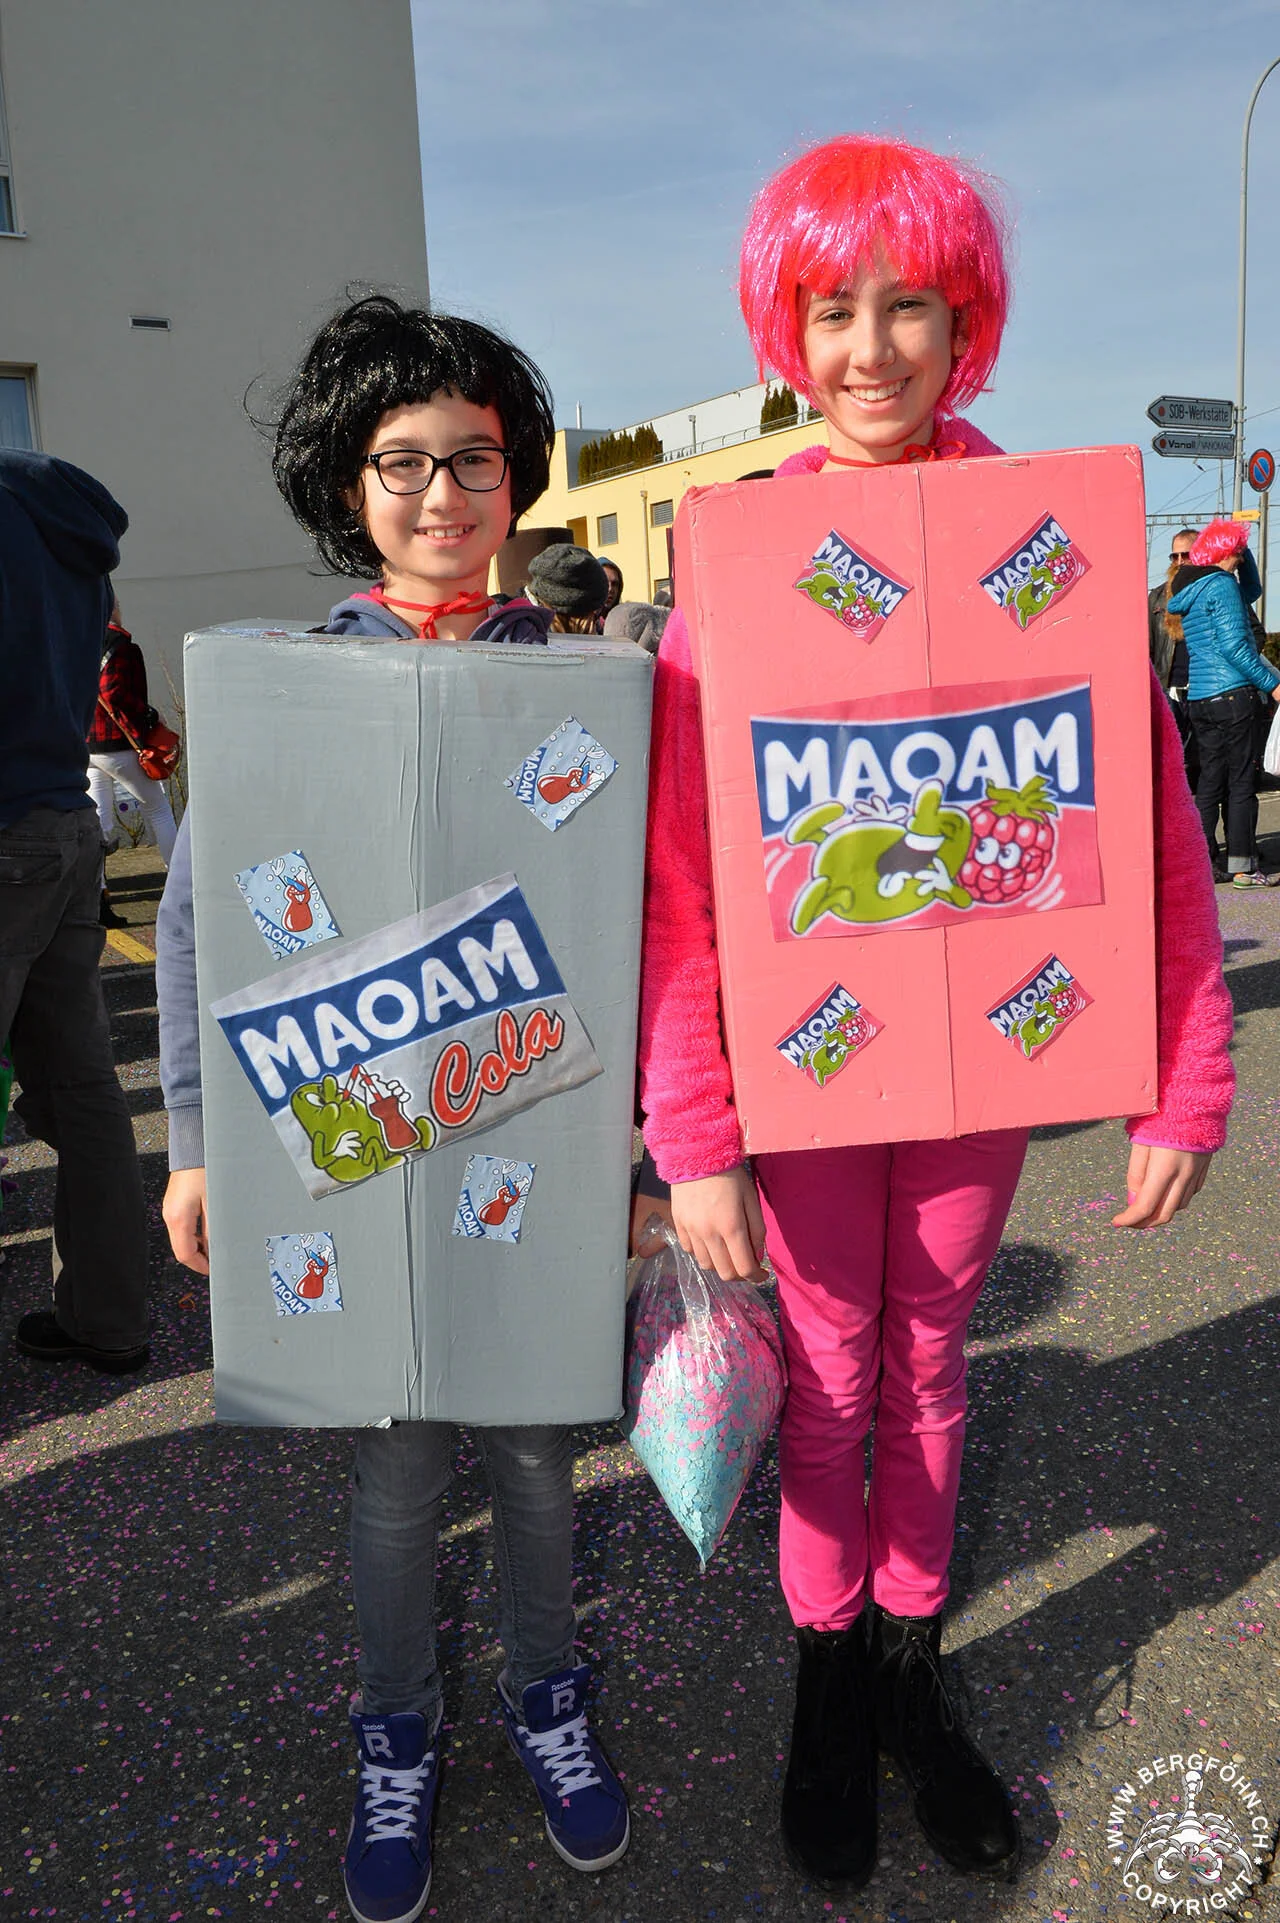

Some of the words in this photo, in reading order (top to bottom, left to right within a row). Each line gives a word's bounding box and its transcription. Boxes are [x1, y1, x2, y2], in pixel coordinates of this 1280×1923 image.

[813, 536, 903, 614] MAOAM
[983, 521, 1068, 604] MAOAM
[764, 712, 1080, 822] MAOAM
[254, 915, 302, 953] MAOAM
[239, 918, 539, 1099] MAOAM
[780, 989, 858, 1068] MAOAM
[990, 960, 1071, 1036] MAOAM
[429, 1007, 565, 1129] Cola
[551, 1678, 575, 1692] Reebok
